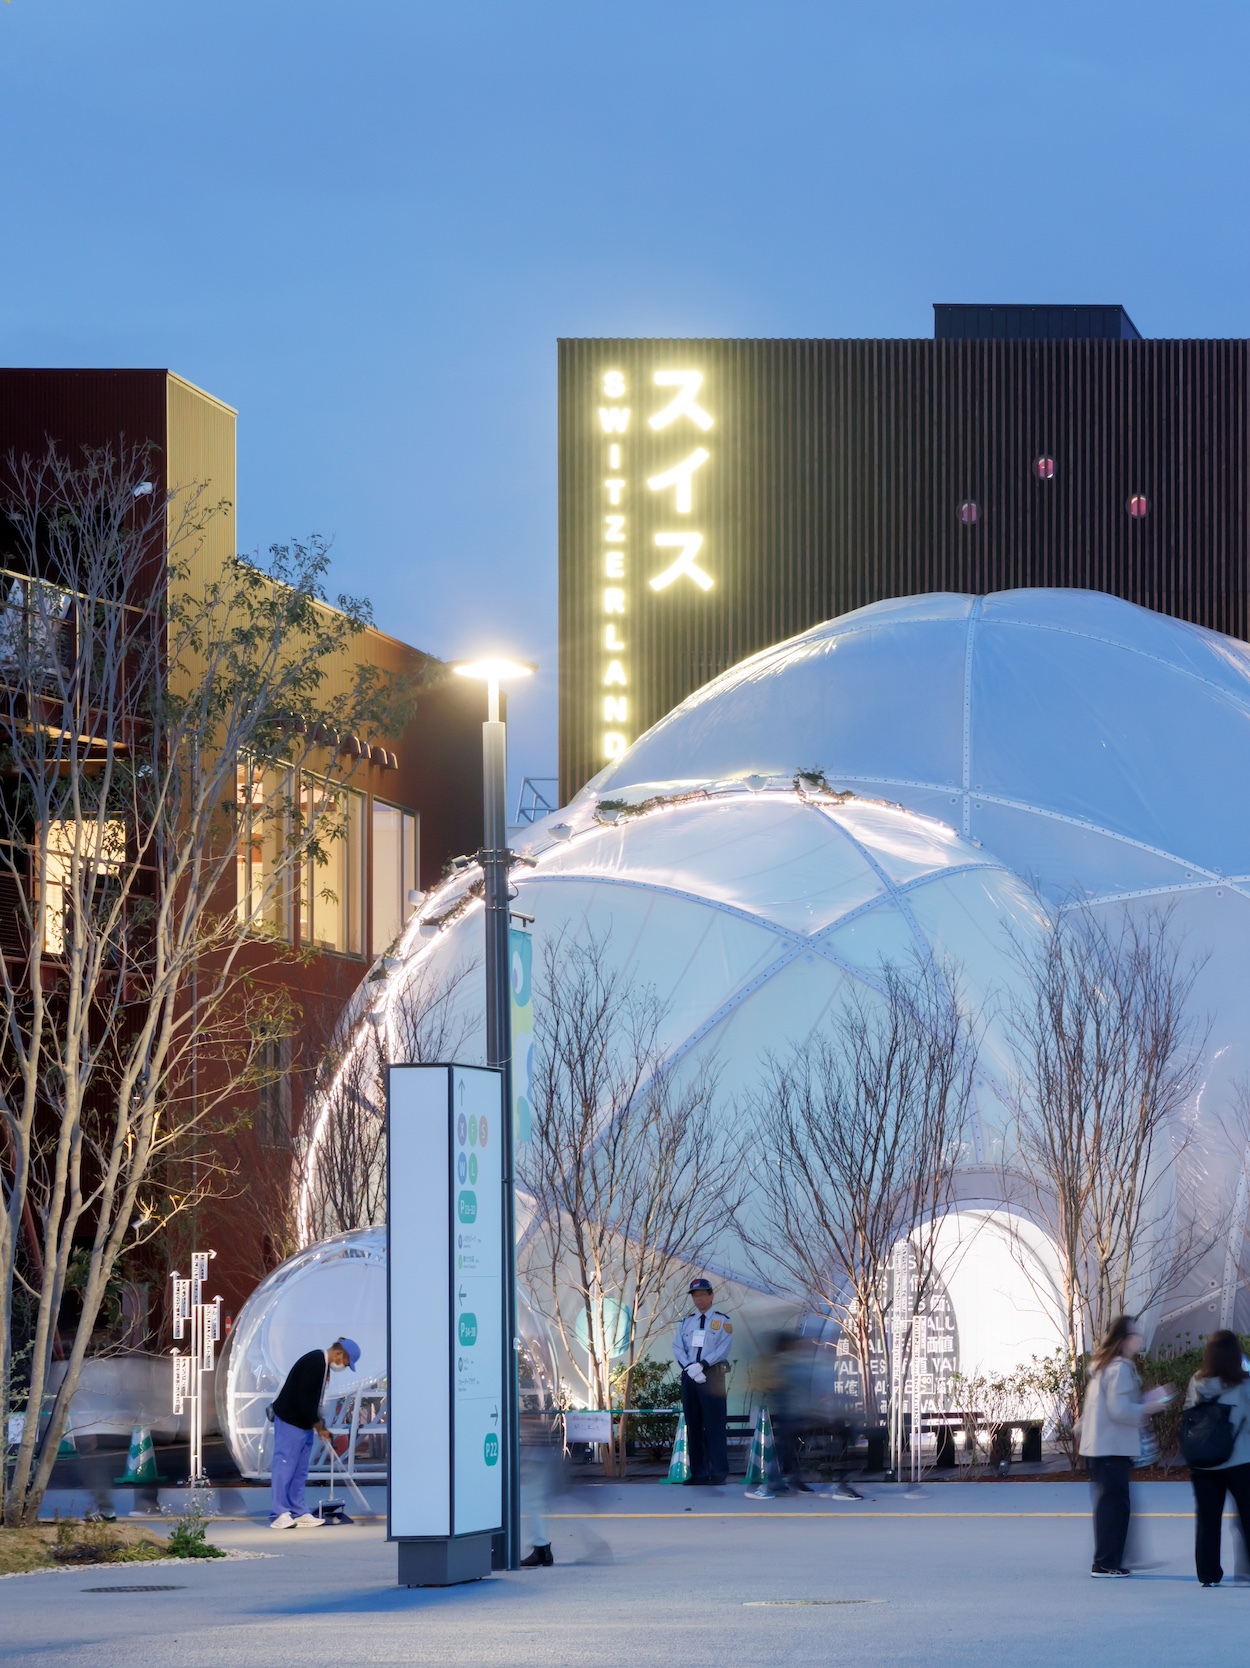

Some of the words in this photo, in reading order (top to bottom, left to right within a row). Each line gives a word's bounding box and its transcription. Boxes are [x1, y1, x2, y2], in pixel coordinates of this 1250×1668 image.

[600, 371, 630, 760] SWITZERLAND
[647, 370, 714, 591] スイス
[485, 1442, 497, 1457] P22
